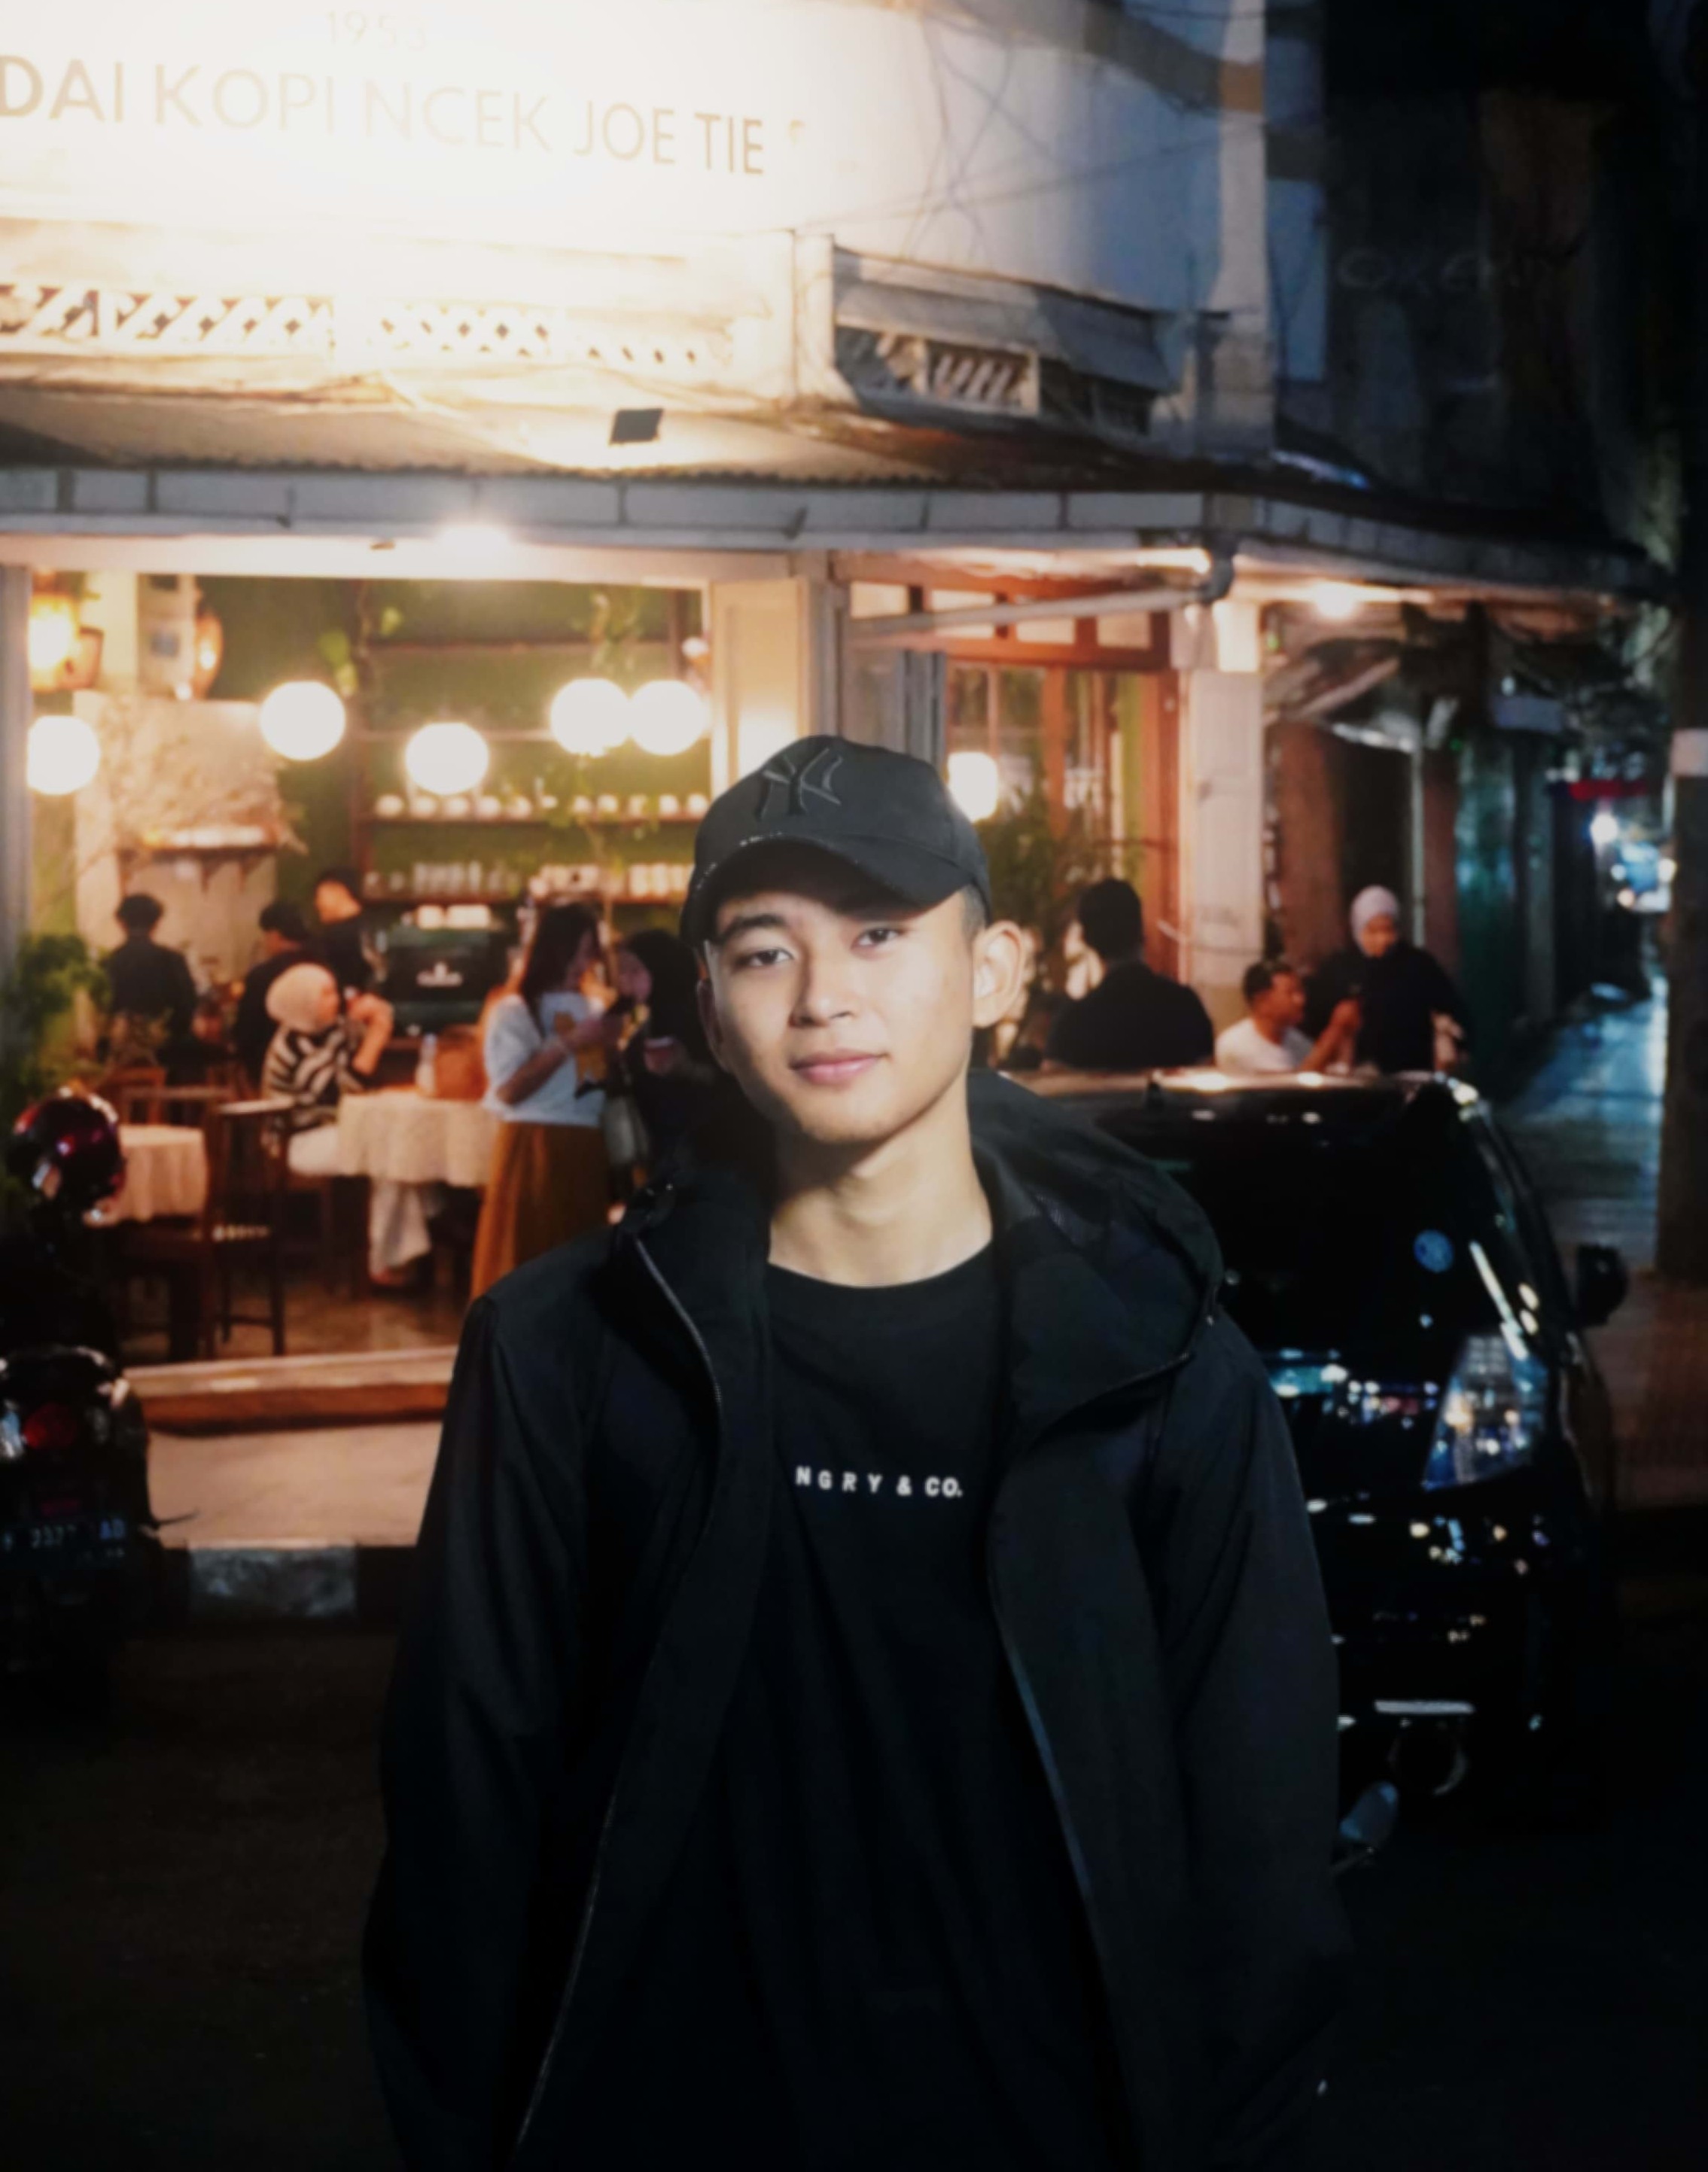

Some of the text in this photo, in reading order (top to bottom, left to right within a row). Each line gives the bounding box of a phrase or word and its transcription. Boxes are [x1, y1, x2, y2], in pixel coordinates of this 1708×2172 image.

[0, 54, 766, 177] DAI KOPI NCEK JOE TIE
[795, 1466, 963, 1498] NGRY & CO.
